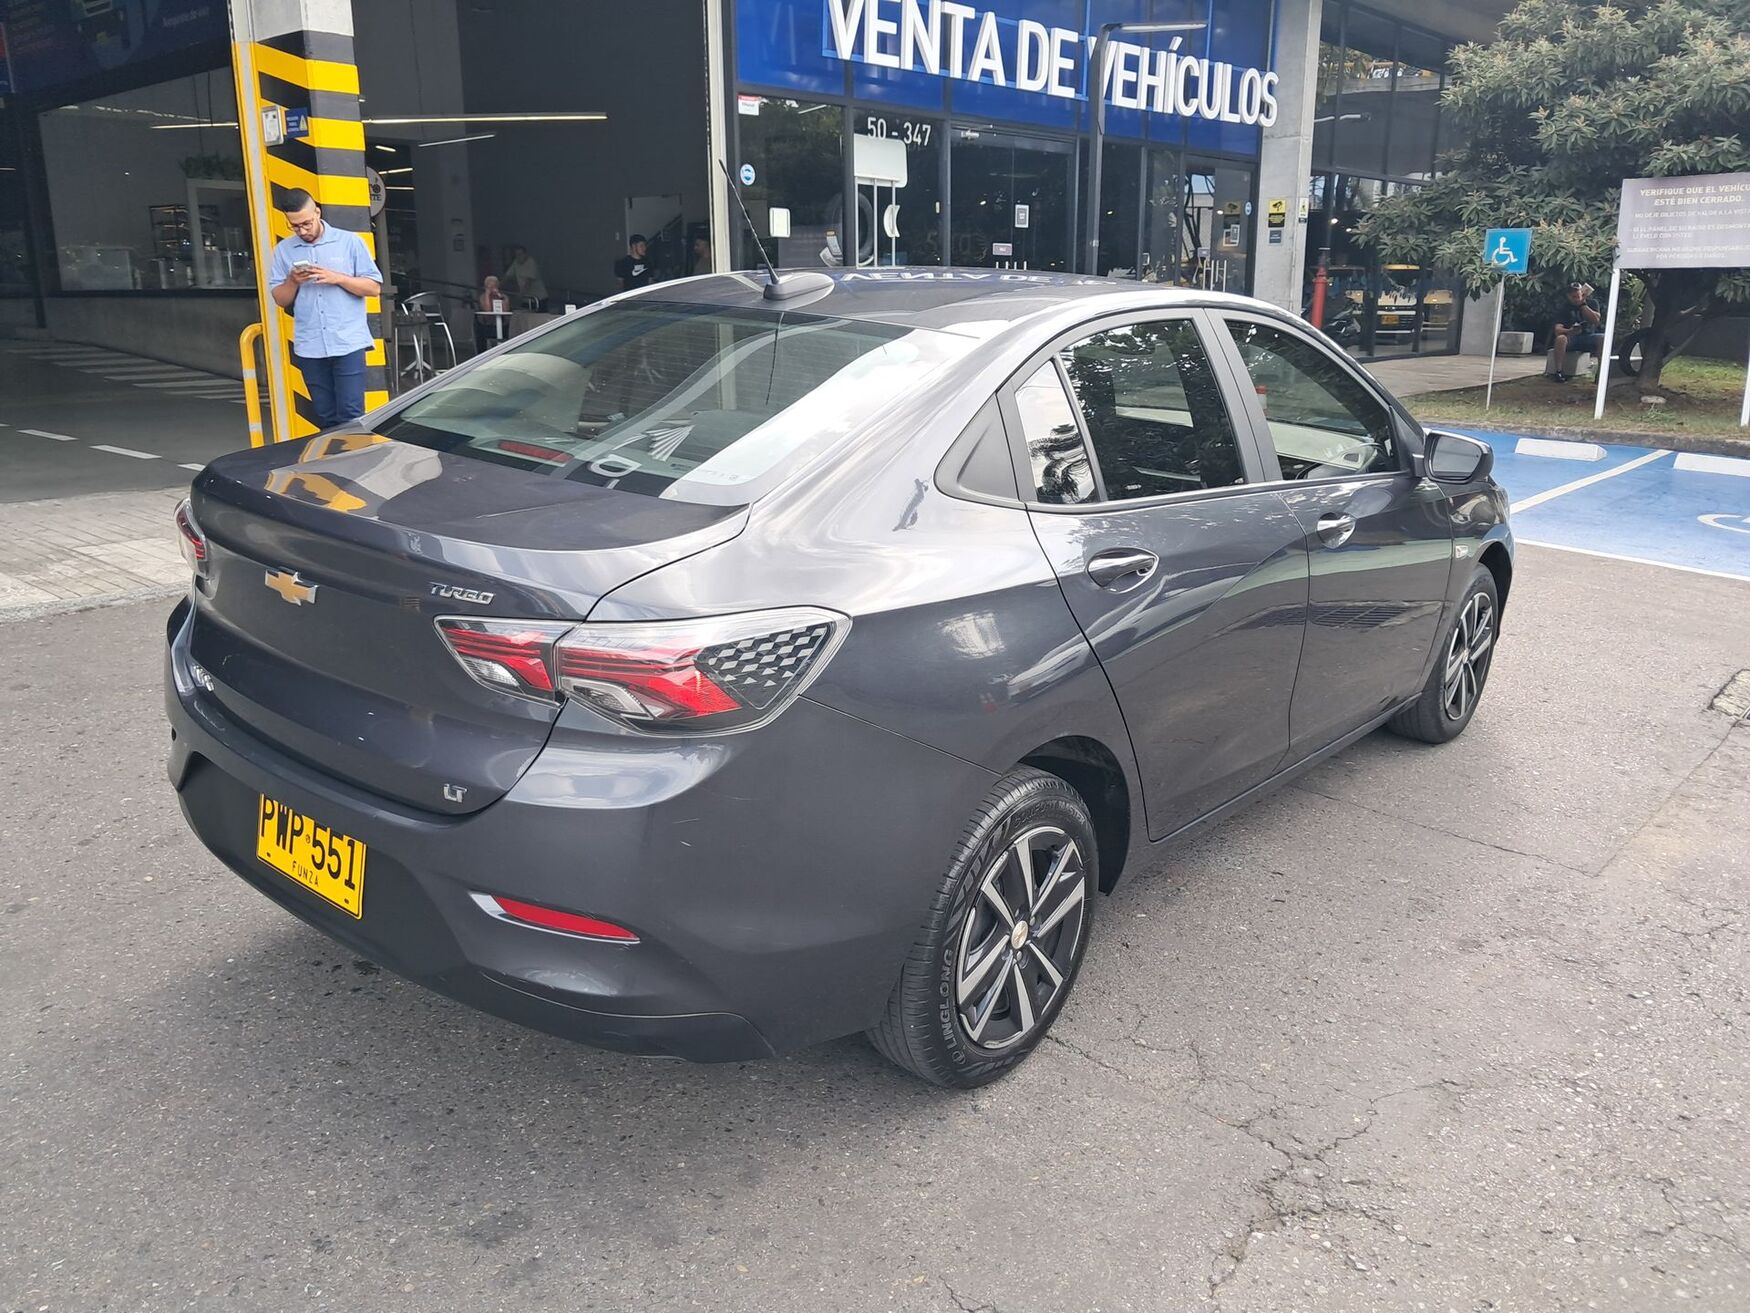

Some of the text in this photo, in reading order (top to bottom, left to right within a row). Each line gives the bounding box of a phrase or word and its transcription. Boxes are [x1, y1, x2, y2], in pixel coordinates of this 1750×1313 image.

[828, 0, 1006, 87] VENTA
[1016, 19, 1079, 99] DE
[868, 117, 887, 140] 50
[903, 121, 931, 146] 347
[1640, 188, 1684, 197] VERIFIQUE
[1686, 186, 1704, 195] QUE
[1677, 197, 1698, 205] BIEN
[429, 582, 496, 605] TURBO
[443, 783, 468, 803] LT
[261, 796, 355, 890] PWP 551
[292, 860, 319, 887] FUNZA
[940, 949, 958, 1050] LINGLONG
